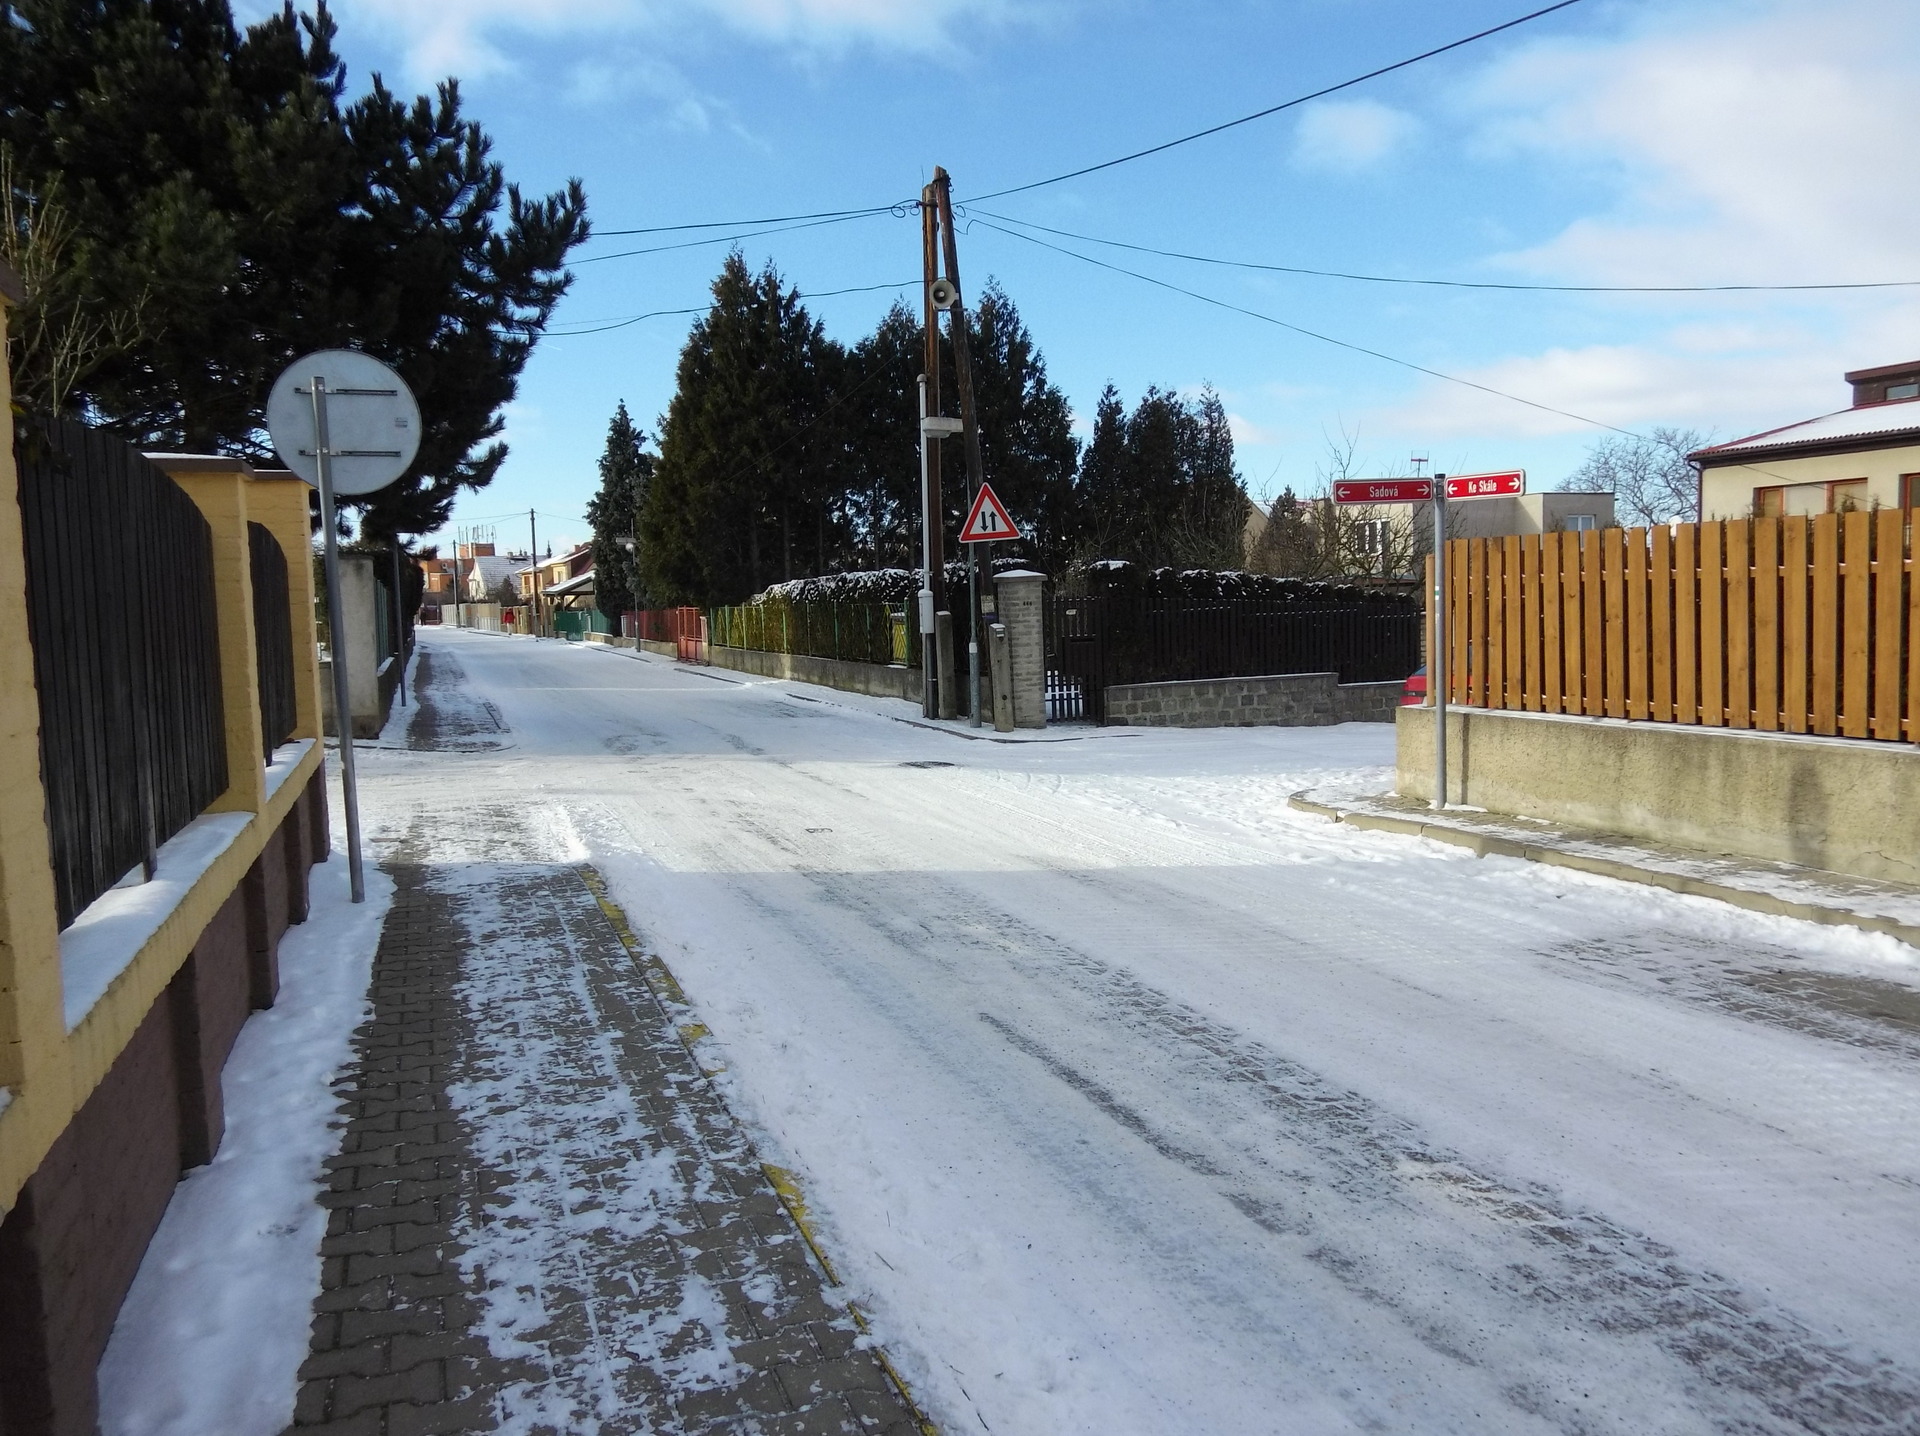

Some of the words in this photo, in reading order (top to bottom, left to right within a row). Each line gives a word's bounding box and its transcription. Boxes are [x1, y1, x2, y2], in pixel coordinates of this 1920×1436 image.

[1369, 485, 1399, 497] Sadová
[1468, 481, 1477, 493] Ke
[1479, 480, 1497, 492] Skále
